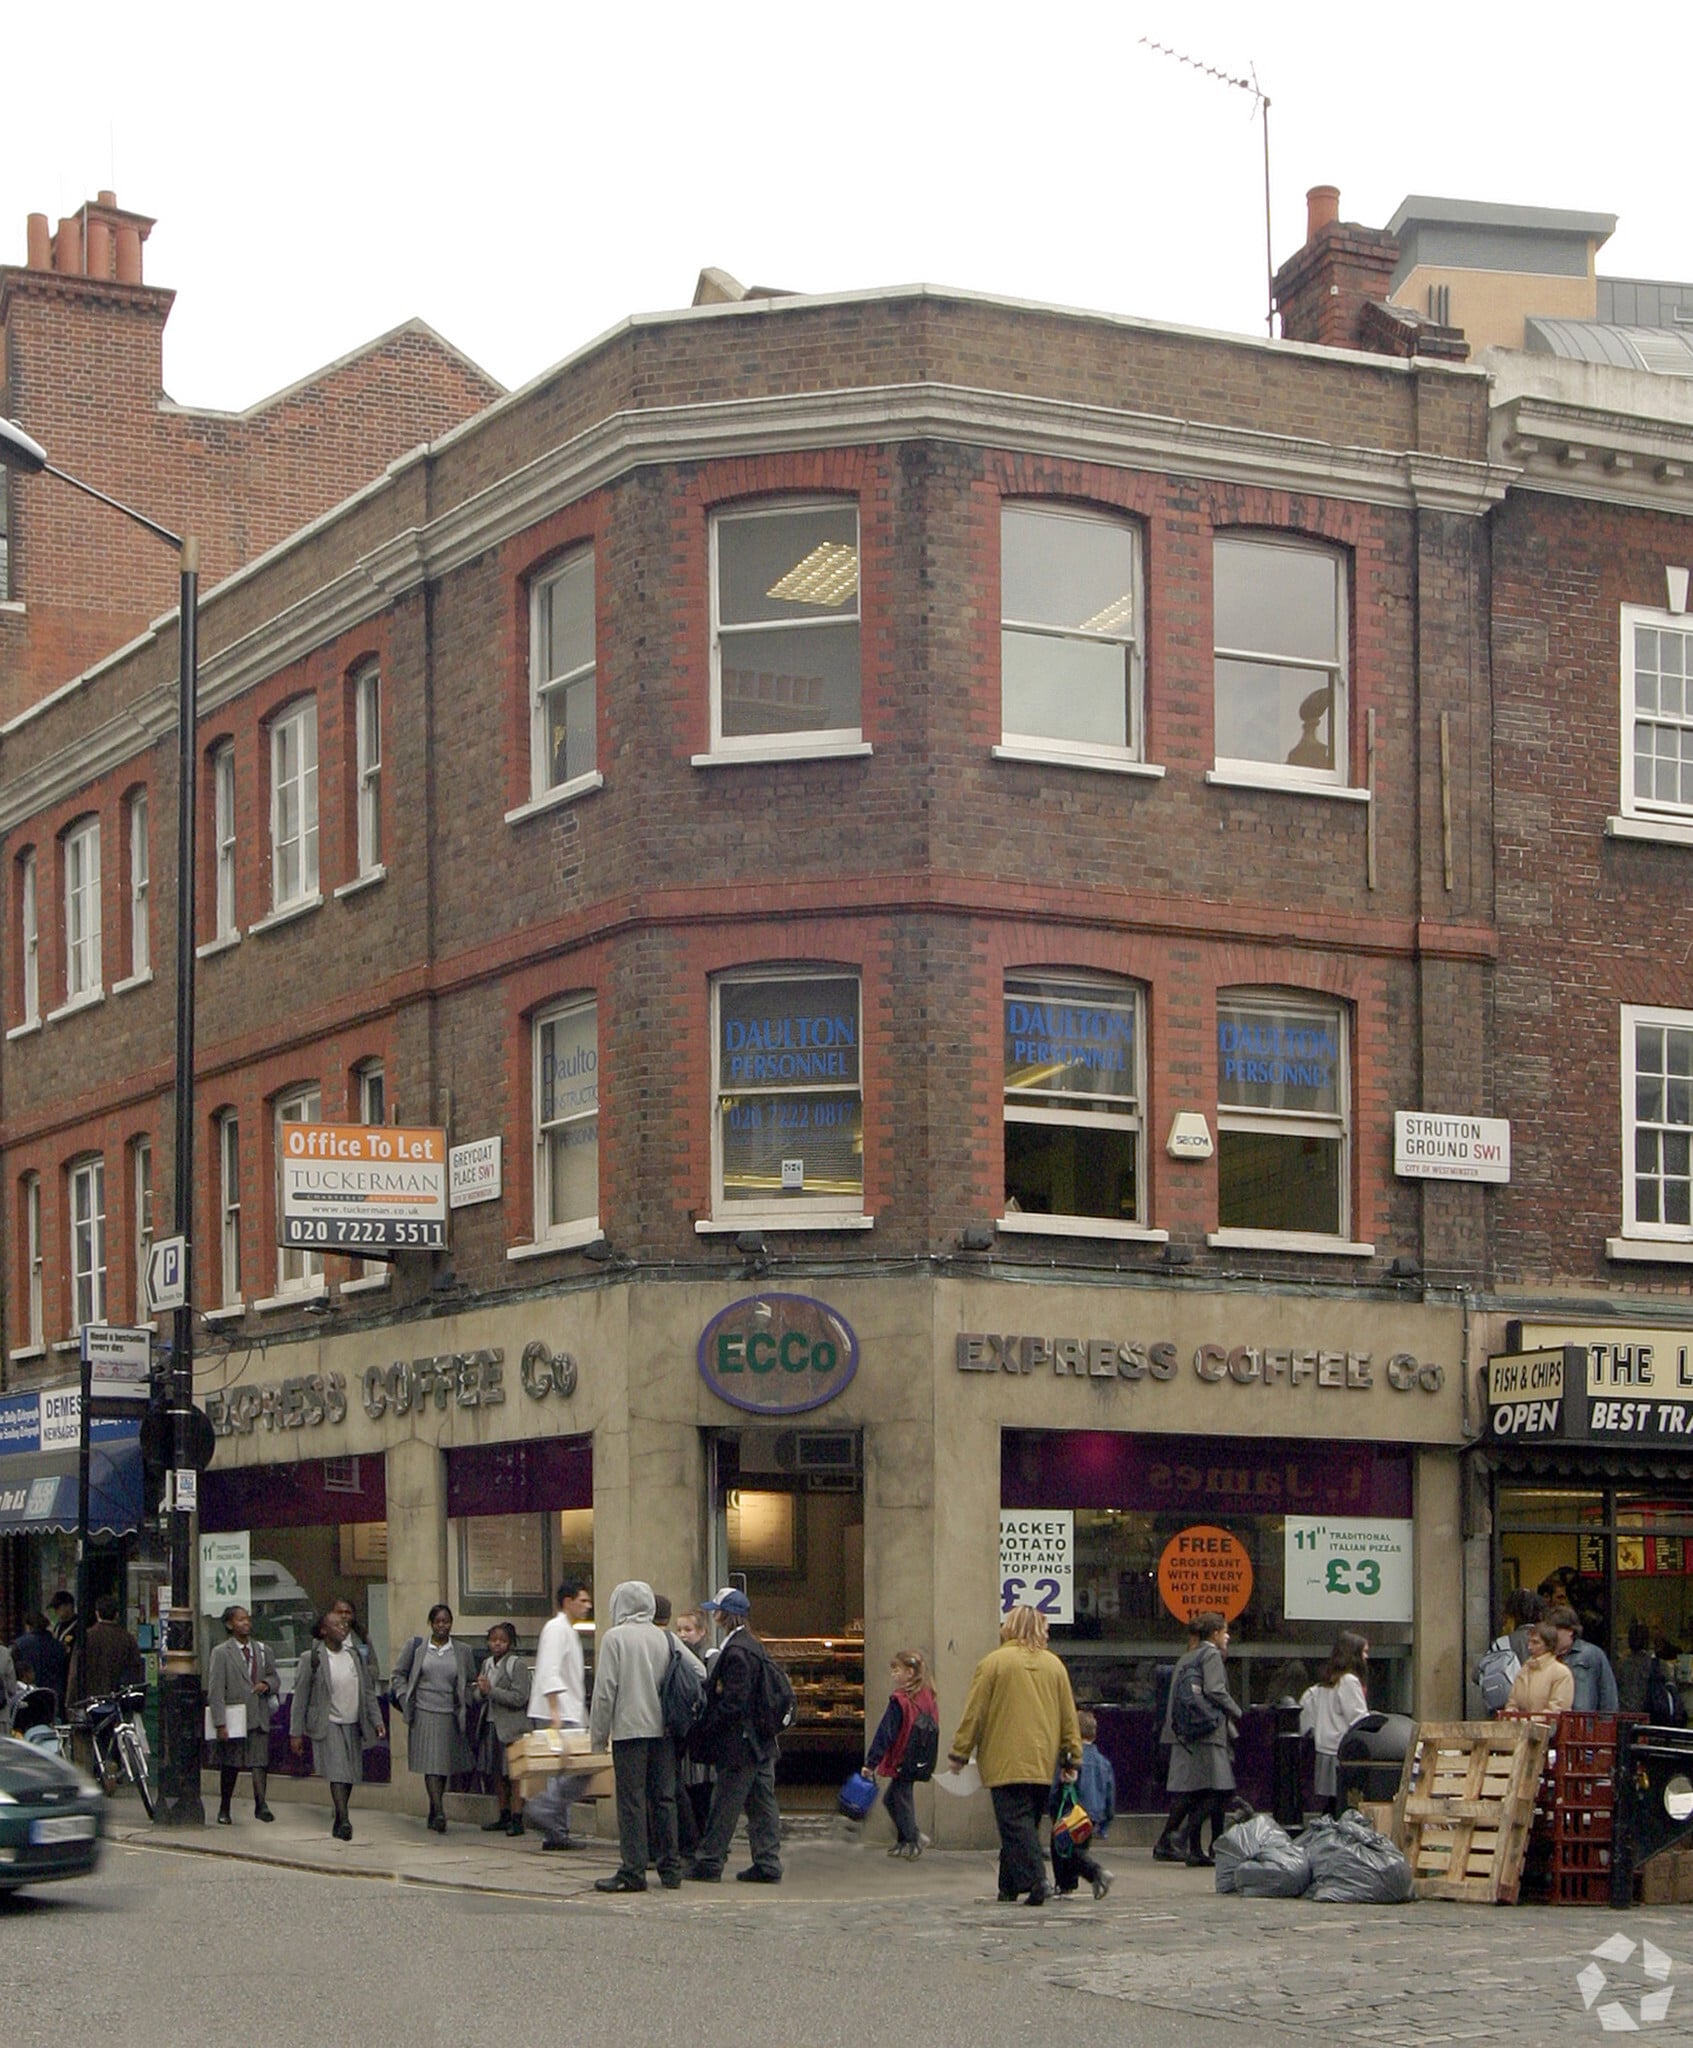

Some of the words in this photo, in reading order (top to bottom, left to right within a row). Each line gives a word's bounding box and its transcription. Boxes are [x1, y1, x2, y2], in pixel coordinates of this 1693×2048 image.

[726, 1016, 855, 1051] DAULTON
[1009, 1001, 1134, 1043] DAULTON
[1219, 1022, 1336, 1060] DAULTON
[731, 1052, 848, 1079] PERSONNEL
[1015, 1041, 1126, 1071] PERSONNEL
[1225, 1059, 1331, 1088] PERSONNEL
[1176, 1135, 1208, 1146] SECOM
[1406, 1119, 1480, 1139] STRUTTON
[289, 1131, 361, 1155] Office
[367, 1135, 391, 1157] To
[398, 1137, 433, 1159] Let
[453, 1144, 492, 1168] GREYCOAT
[1406, 1139, 1468, 1158] GROUND
[1474, 1144, 1501, 1161] SW1
[290, 1170, 439, 1191] TUCKERMAN
[454, 1167, 476, 1186] PLACE
[478, 1163, 494, 1180] SW1
[1405, 1165, 1419, 1173] CITY
[1433, 1166, 1478, 1176] WESTMINSTER
[312, 1206, 419, 1216] www.tuckerman.co.uk
[290, 1221, 327, 1240] 020
[337, 1222, 386, 1241] 7222
[395, 1224, 442, 1243] 5511
[166, 1250, 176, 1283] P
[718, 1332, 836, 1373] ECCo
[957, 1332, 1178, 1382] EXPRESS
[1195, 1343, 1373, 1389] COFFEE
[1387, 1353, 1446, 1392] Co
[1589, 1342, 1654, 1386] THE
[204, 1372, 347, 1437] EXPRESS
[362, 1347, 505, 1419] COFFEE
[520, 1340, 578, 1399] Co
[1494, 1368, 1517, 1392] FISH
[1520, 1366, 1527, 1388] &
[1531, 1361, 1562, 1388] CHIPS
[1493, 1401, 1559, 1435] OPEN
[1591, 1402, 1651, 1431] BEST
[1179, 1537, 1232, 1552] FREE
[1294, 1526, 1326, 1550] 11"
[1330, 1532, 1391, 1541] TRADITIONAL
[1329, 1543, 1366, 1552] ITALIAN
[1369, 1543, 1401, 1552] PIZZAS
[1003, 1563, 1071, 1574] TOPPINGS
[1037, 1552, 1065, 1562] ANY
[1170, 1558, 1240, 1568] CROISSANT
[216, 1566, 238, 1595] £3
[1168, 1570, 1199, 1580] WITH
[1204, 1570, 1243, 1580] EVERY
[1325, 1558, 1381, 1595] £3
[1001, 1578, 1061, 1614] £2
[1171, 1583, 1196, 1592] HOT
[1201, 1583, 1240, 1593] DRINK
[1182, 1595, 1229, 1604] BEFORE
